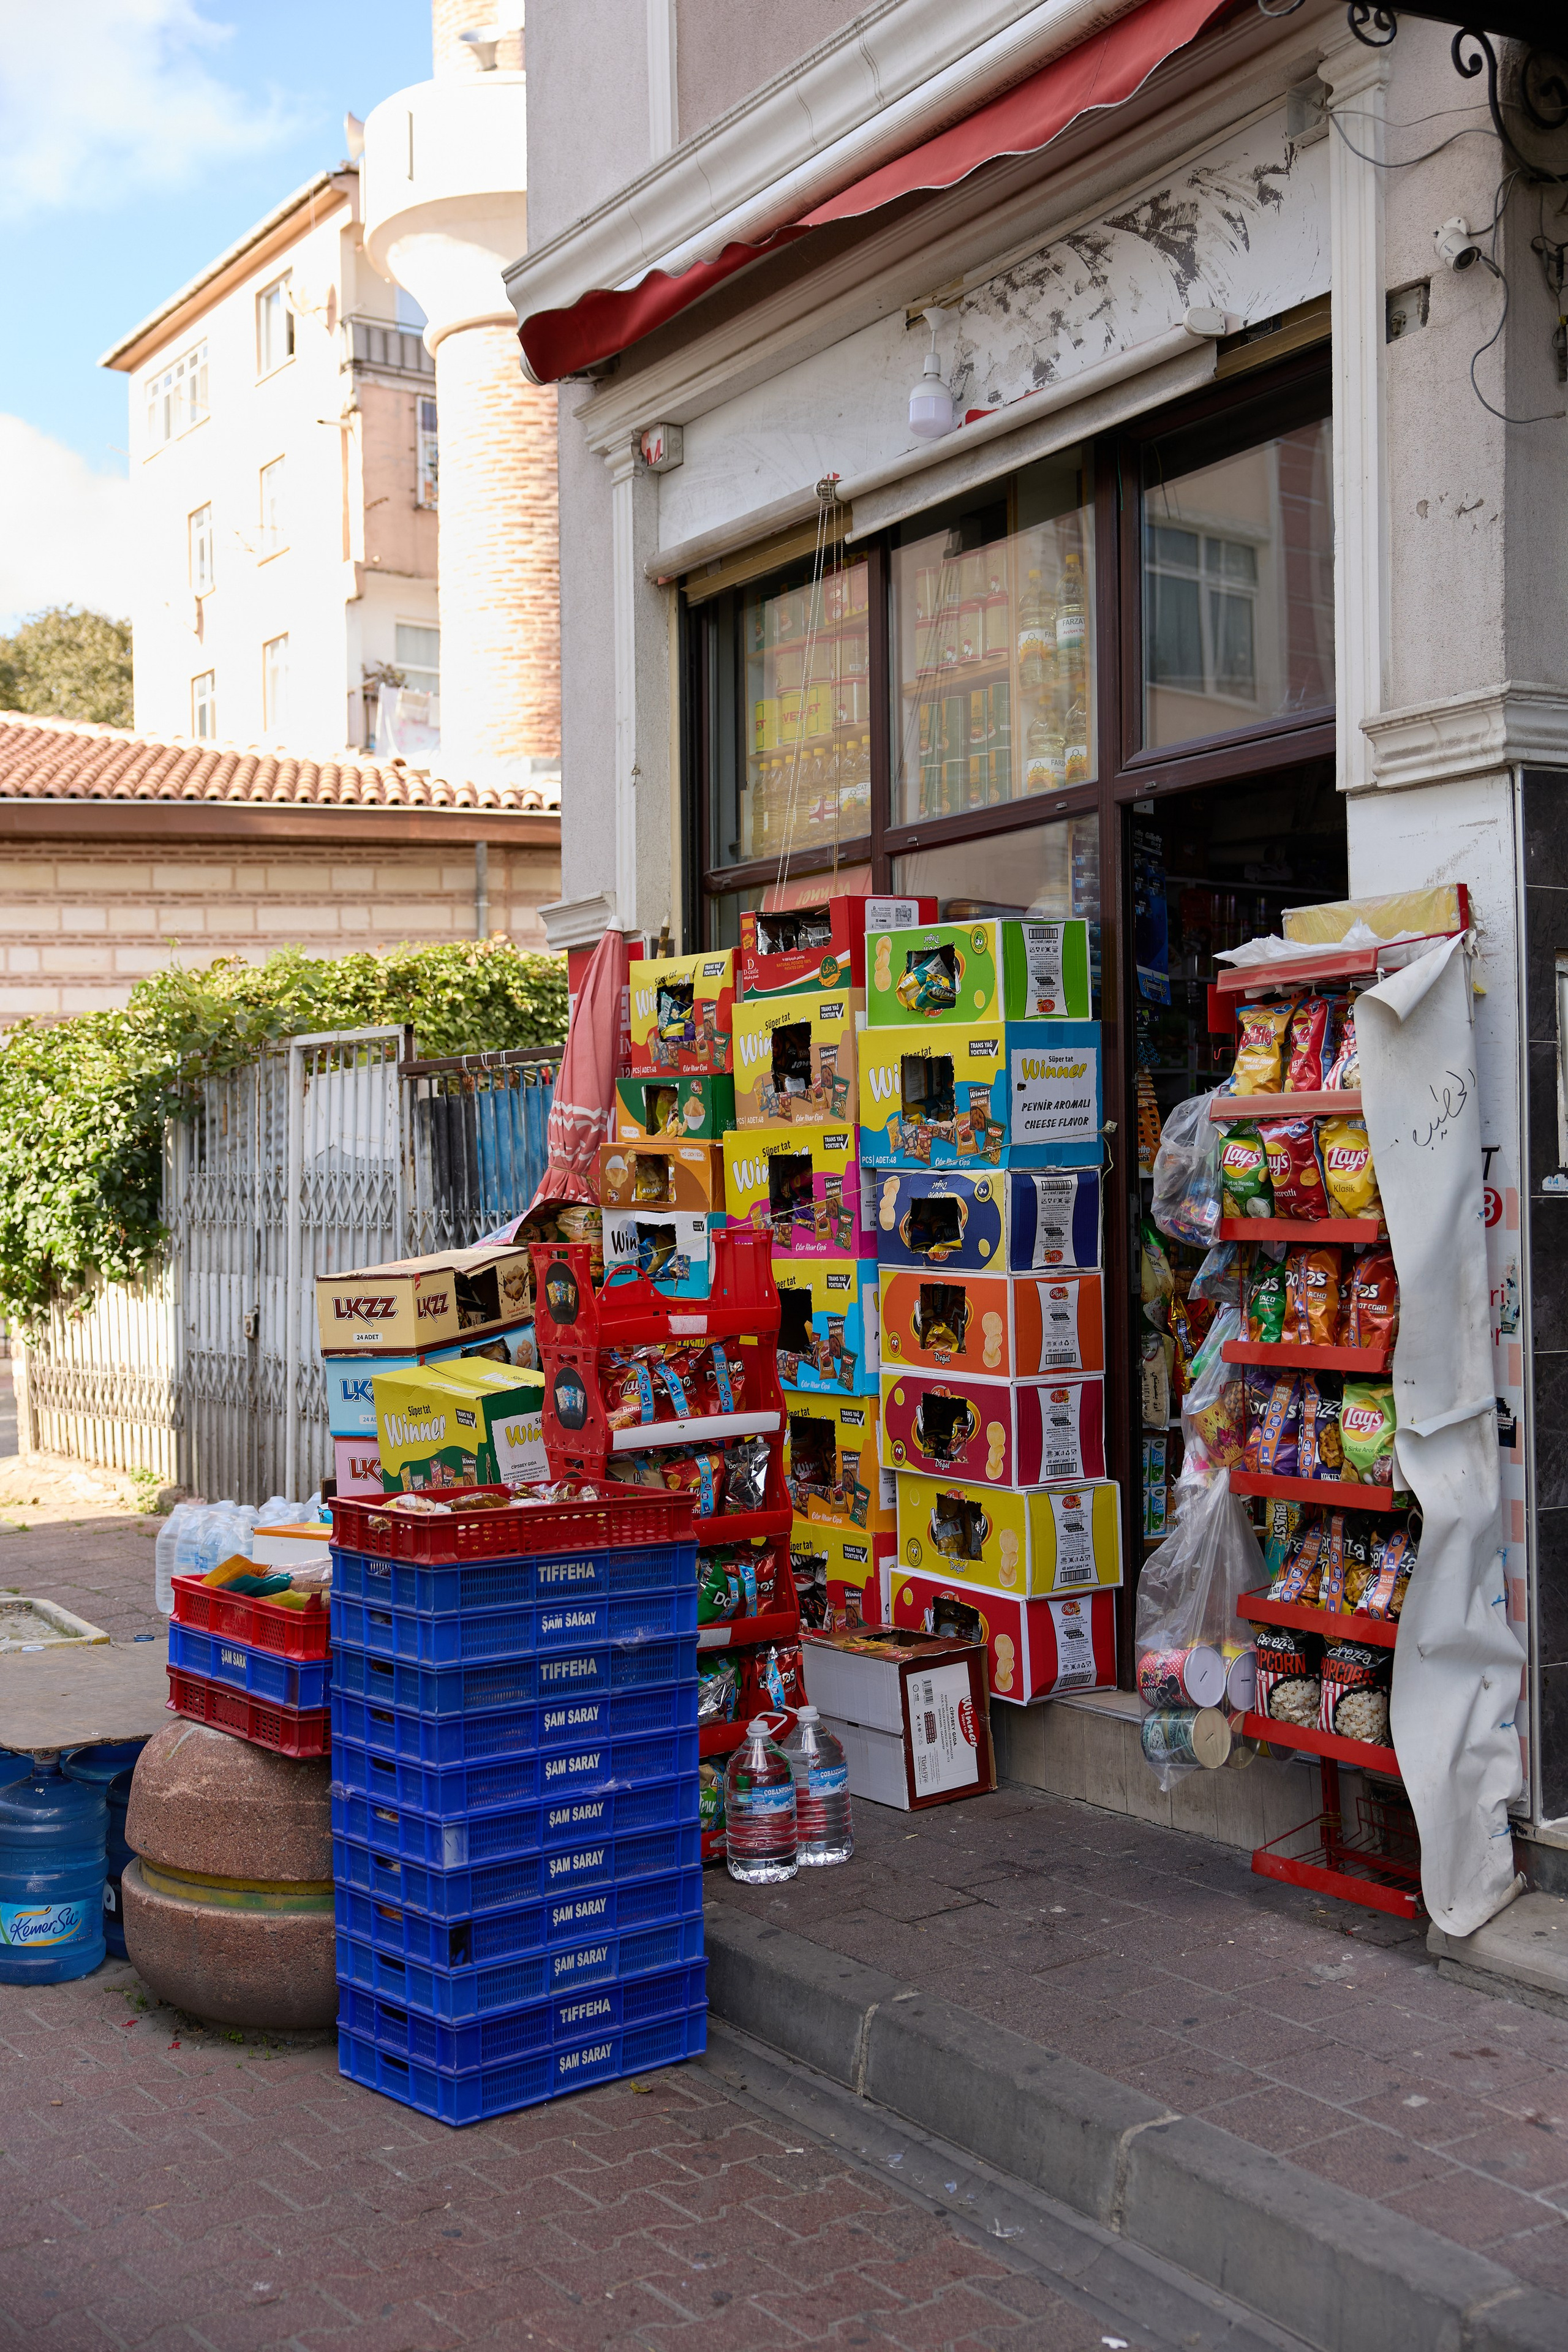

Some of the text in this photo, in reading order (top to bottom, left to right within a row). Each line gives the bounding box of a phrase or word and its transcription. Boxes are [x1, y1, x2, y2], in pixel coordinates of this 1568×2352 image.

[765, 1012, 790, 1030] Süper tat
[1239, 1024, 1278, 1051] Ruffles
[921, 1046, 931, 1056] tat
[1022, 1058, 1087, 1080] Winner
[970, 1090, 990, 1098] Winner
[1022, 1099, 1090, 1112] PEYNİR AROMALI
[1025, 1117, 1089, 1129] CHEESE FLAVOR
[762, 1140, 791, 1158] Süper tat
[1223, 1145, 1261, 1168] Lay's
[1329, 1147, 1369, 1172] Lay's
[1267, 1153, 1289, 1177] ay's
[787, 1275, 796, 1286] tat
[332, 1295, 399, 1326] LKZZ
[416, 1291, 450, 1323] LKZZ
[933, 1352, 951, 1365] Doğal
[408, 1405, 423, 1417] Süper
[801, 1408, 810, 1417] tat
[1344, 1408, 1382, 1433] Lay's
[383, 1413, 446, 1449] Winner
[1273, 1504, 1286, 1540] BLAST
[804, 1540, 812, 1550] tat
[538, 1561, 595, 1583] TIFFEHA
[949, 1561, 965, 1574] Doğal
[221, 1648, 246, 1669] ŞAM SARA
[540, 1658, 597, 1681] TIFFEHA
[1256, 1648, 1306, 1674] OPCORN
[544, 1705, 599, 1732] ŞAM SARAY
[962, 1695, 978, 1747] Winner
[545, 1753, 600, 1780] ŞAM SARAY
[549, 1802, 604, 1828] ŞAM SARAY
[549, 1849, 604, 1878] ŞAM SARAY
[552, 1898, 607, 1926] ŞAM SARAY
[554, 1947, 608, 1977] ŞAM SARAY
[560, 1998, 611, 2024] TIFFEHA
[559, 2043, 612, 2075] ŞAM SARAY
